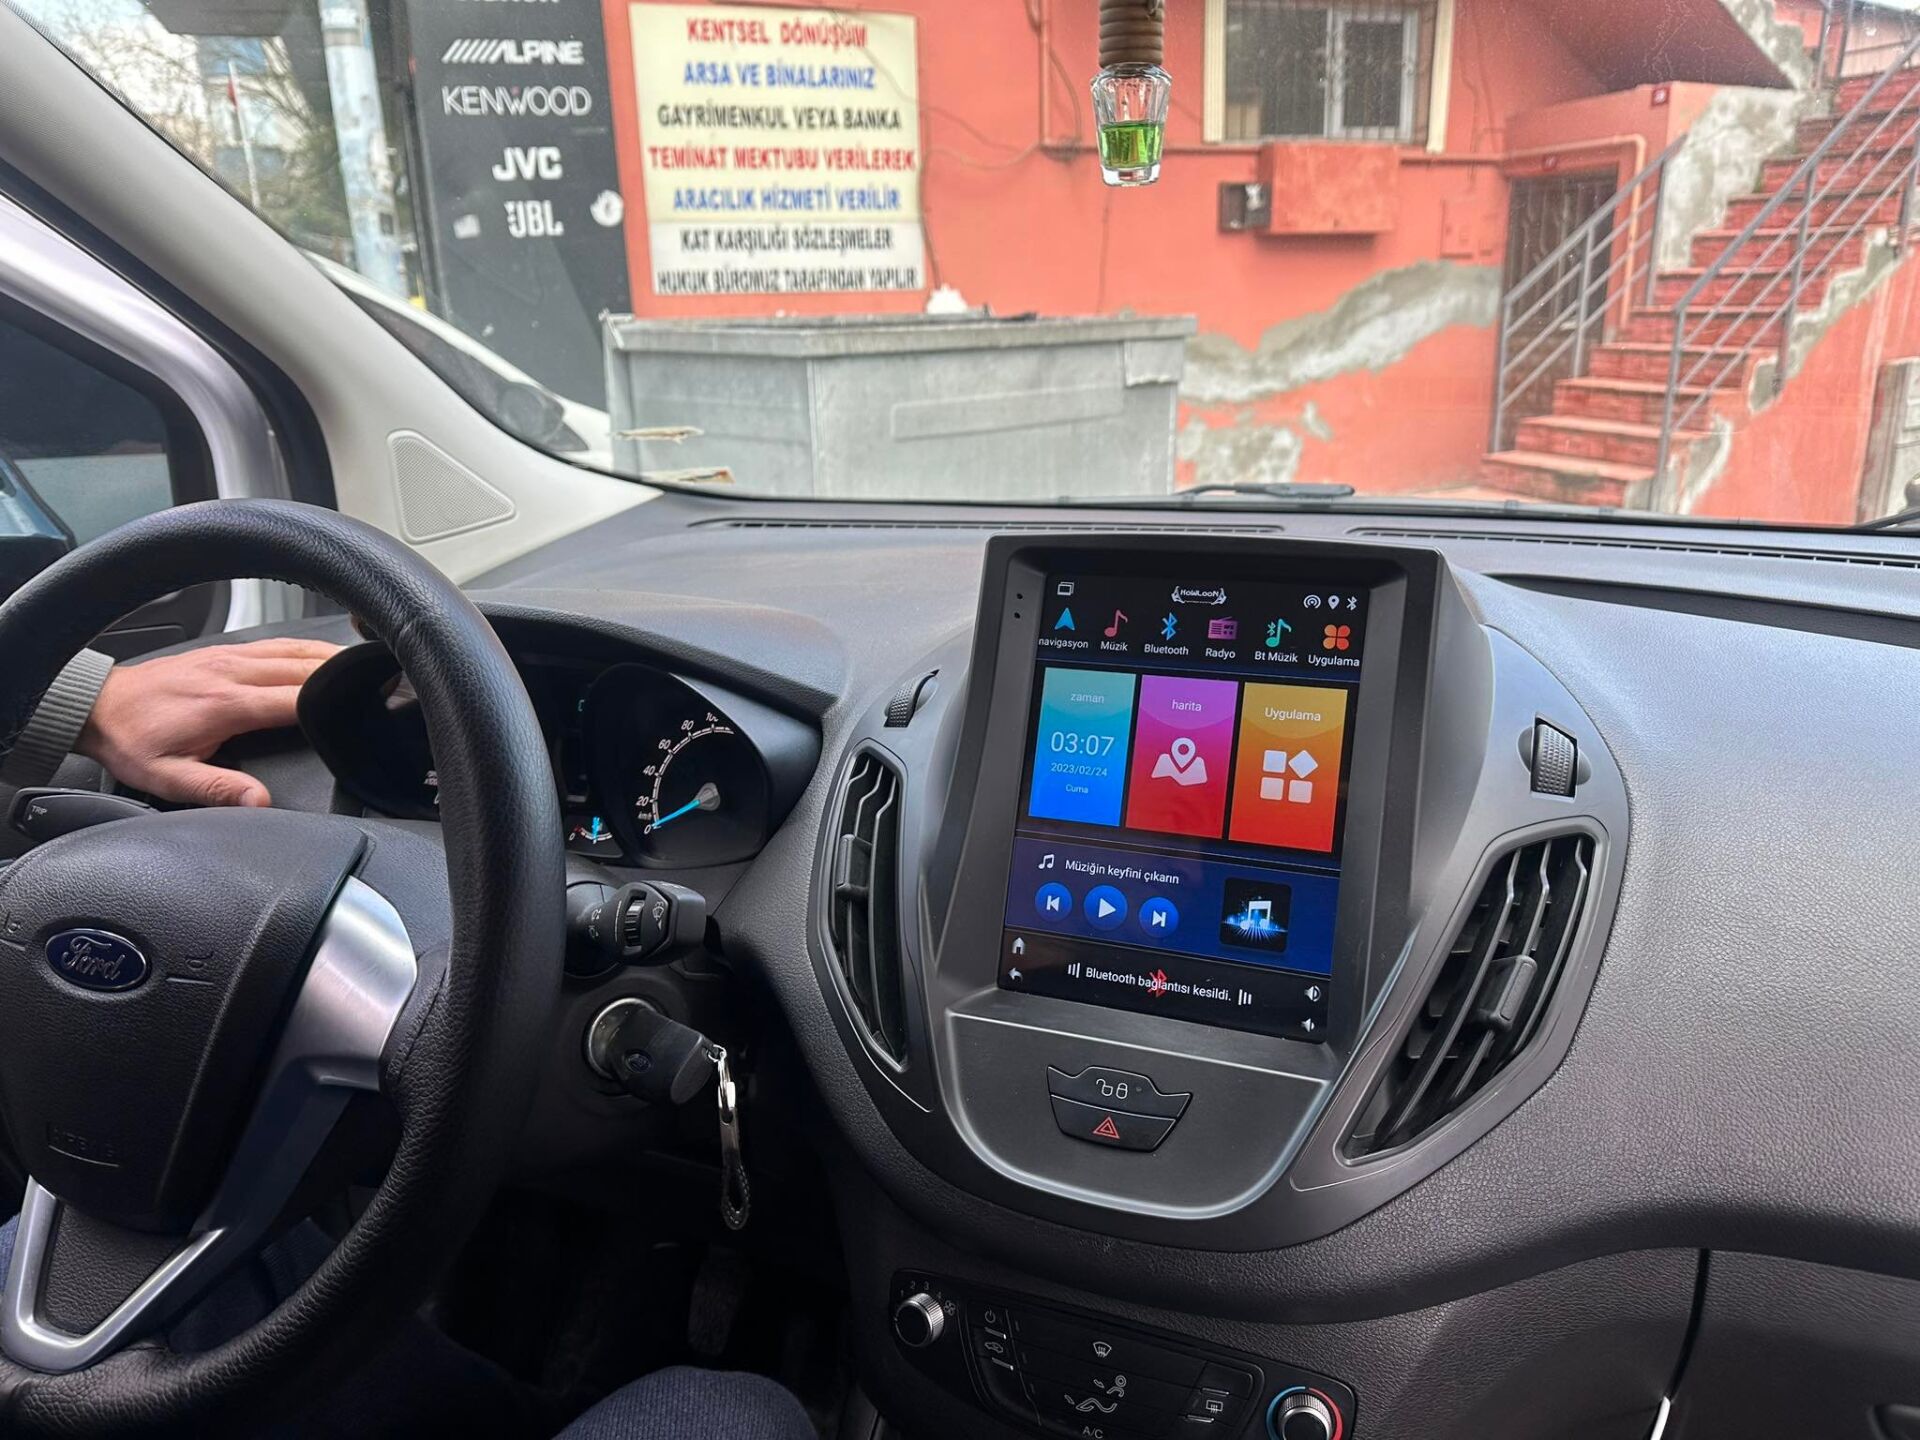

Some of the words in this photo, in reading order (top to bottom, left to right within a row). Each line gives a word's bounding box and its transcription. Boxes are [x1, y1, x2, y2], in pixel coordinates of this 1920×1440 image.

[687, 18, 770, 44] KENTSEL
[684, 61, 732, 85] ARSA
[737, 64, 760, 86] VE
[441, 85, 593, 117] KENWOOD
[657, 99, 789, 129] GAYRİMENKUL
[793, 106, 838, 129] VEYA
[844, 107, 902, 130] BANKA
[650, 140, 728, 169] TEMİNAT
[734, 147, 819, 169] MEKTUBU
[825, 141, 916, 170] VERİLEREK
[491, 146, 563, 182] JVC
[673, 188, 756, 211] ARACILIK
[761, 182, 831, 211] HİZMETİ
[837, 184, 900, 210] VERİLİR
[504, 199, 565, 238] JBL
[681, 228, 710, 251] KAT
[657, 271, 712, 293] HUKUK
[1037, 637, 1090, 650] navigasyon
[1100, 641, 1129, 652] Müzik
[1144, 643, 1190, 656] Bluetooth
[1205, 647, 1236, 661] Radyo
[1254, 650, 1266, 661] Bt
[1267, 651, 1299, 664] Müzik
[1307, 654, 1361, 668] Uygulama
[1070, 691, 1106, 705] zaman
[1171, 699, 1203, 713] harita
[1264, 706, 1322, 723] Uygulama
[681, 720, 694, 730] 80
[658, 739, 671, 749] 60
[1050, 731, 1115, 758] 03:07
[643, 765, 656, 776] 40
[1050, 762, 1108, 778] 2023/02/24
[1065, 783, 1089, 795] Cuma
[636, 796, 650, 806] 20
[644, 824, 651, 834] 0
[1065, 859, 1106, 875] Müziğin
[1107, 864, 1142, 880] keyfini
[1143, 870, 1180, 885] çıkarın
[61, 936, 127, 981] Ford
[1085, 967, 1136, 986] Bluetooth
[1192, 984, 1232, 1002] kesildi.
